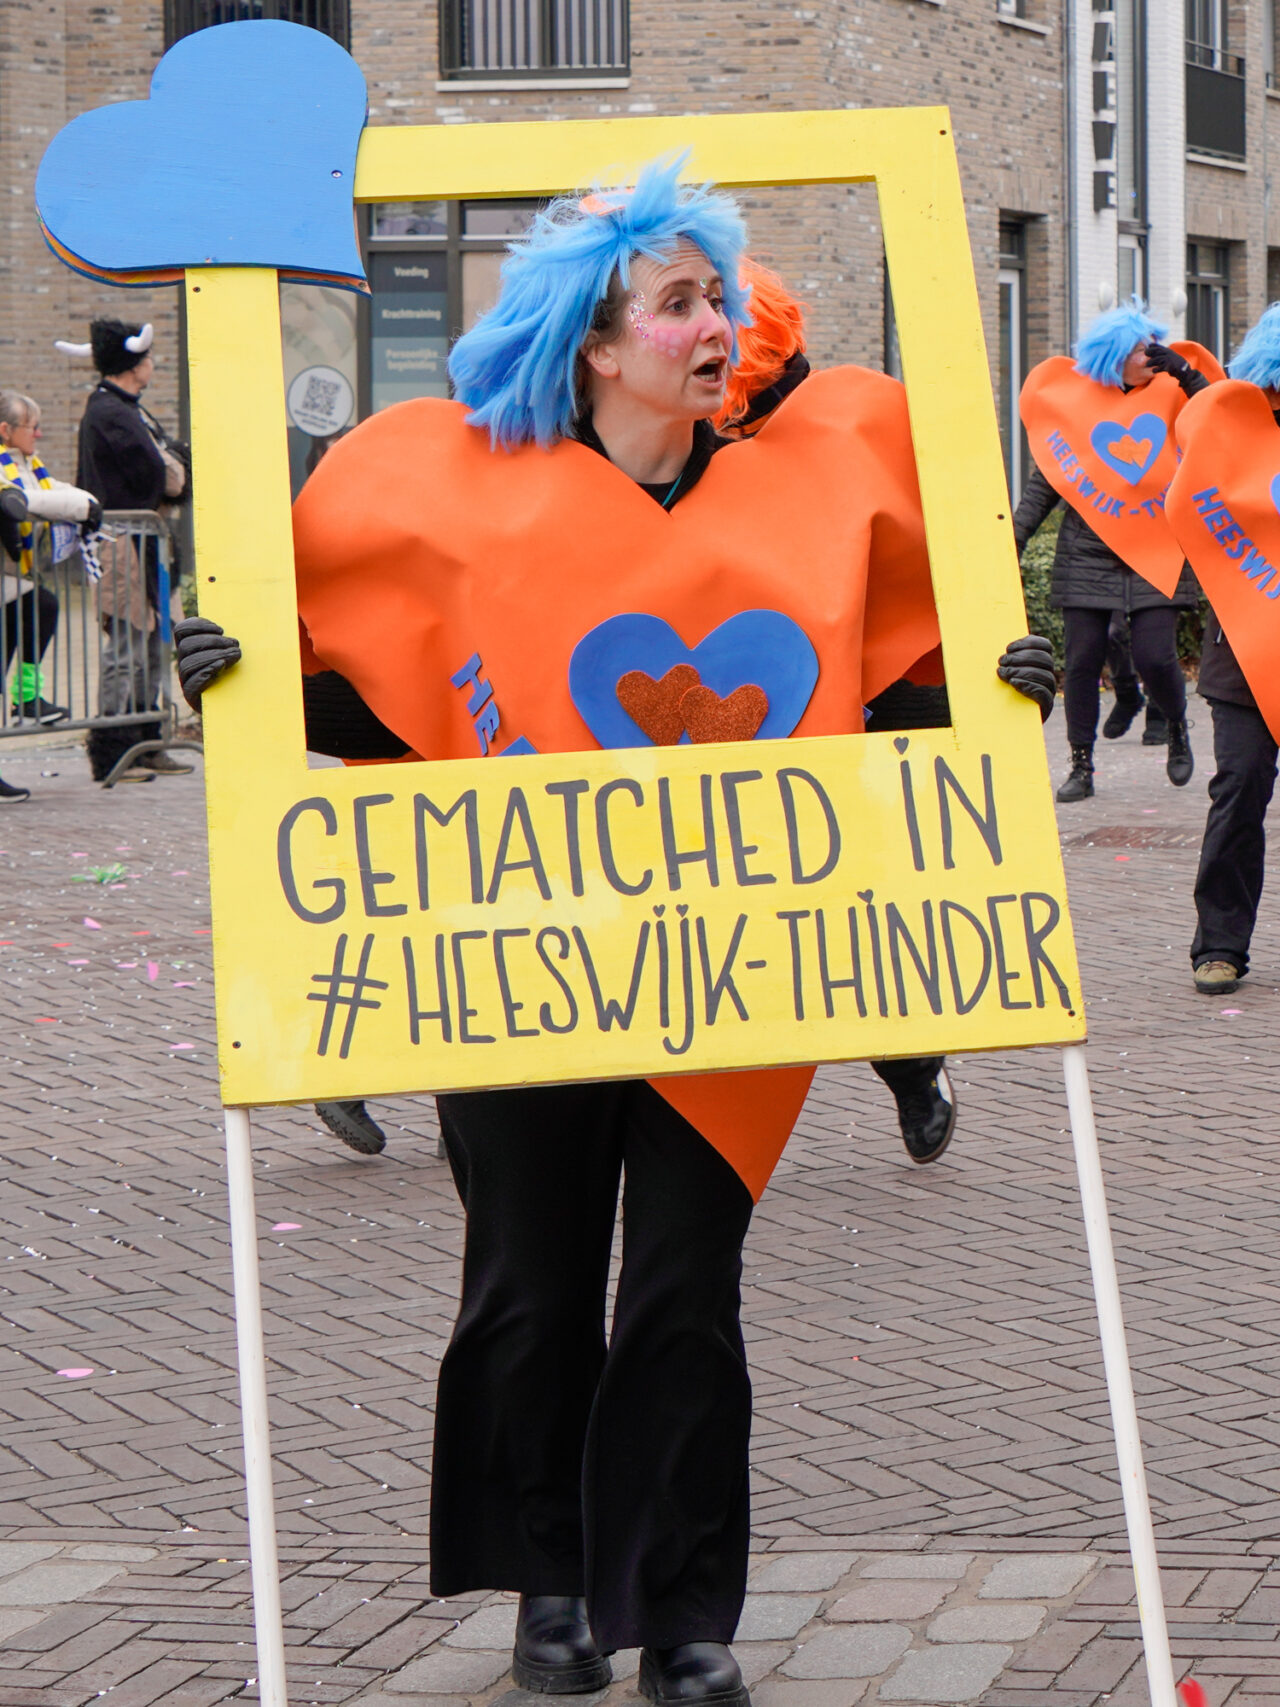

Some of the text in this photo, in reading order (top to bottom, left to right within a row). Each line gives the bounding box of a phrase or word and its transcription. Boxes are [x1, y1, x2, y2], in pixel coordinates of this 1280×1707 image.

[382, 309, 442, 321] Krachttraining
[394, 266, 430, 279] Voeding
[277, 767, 841, 924] GEMATCHED
[307, 889, 1072, 1059] #HEESWIJK-THINDER
